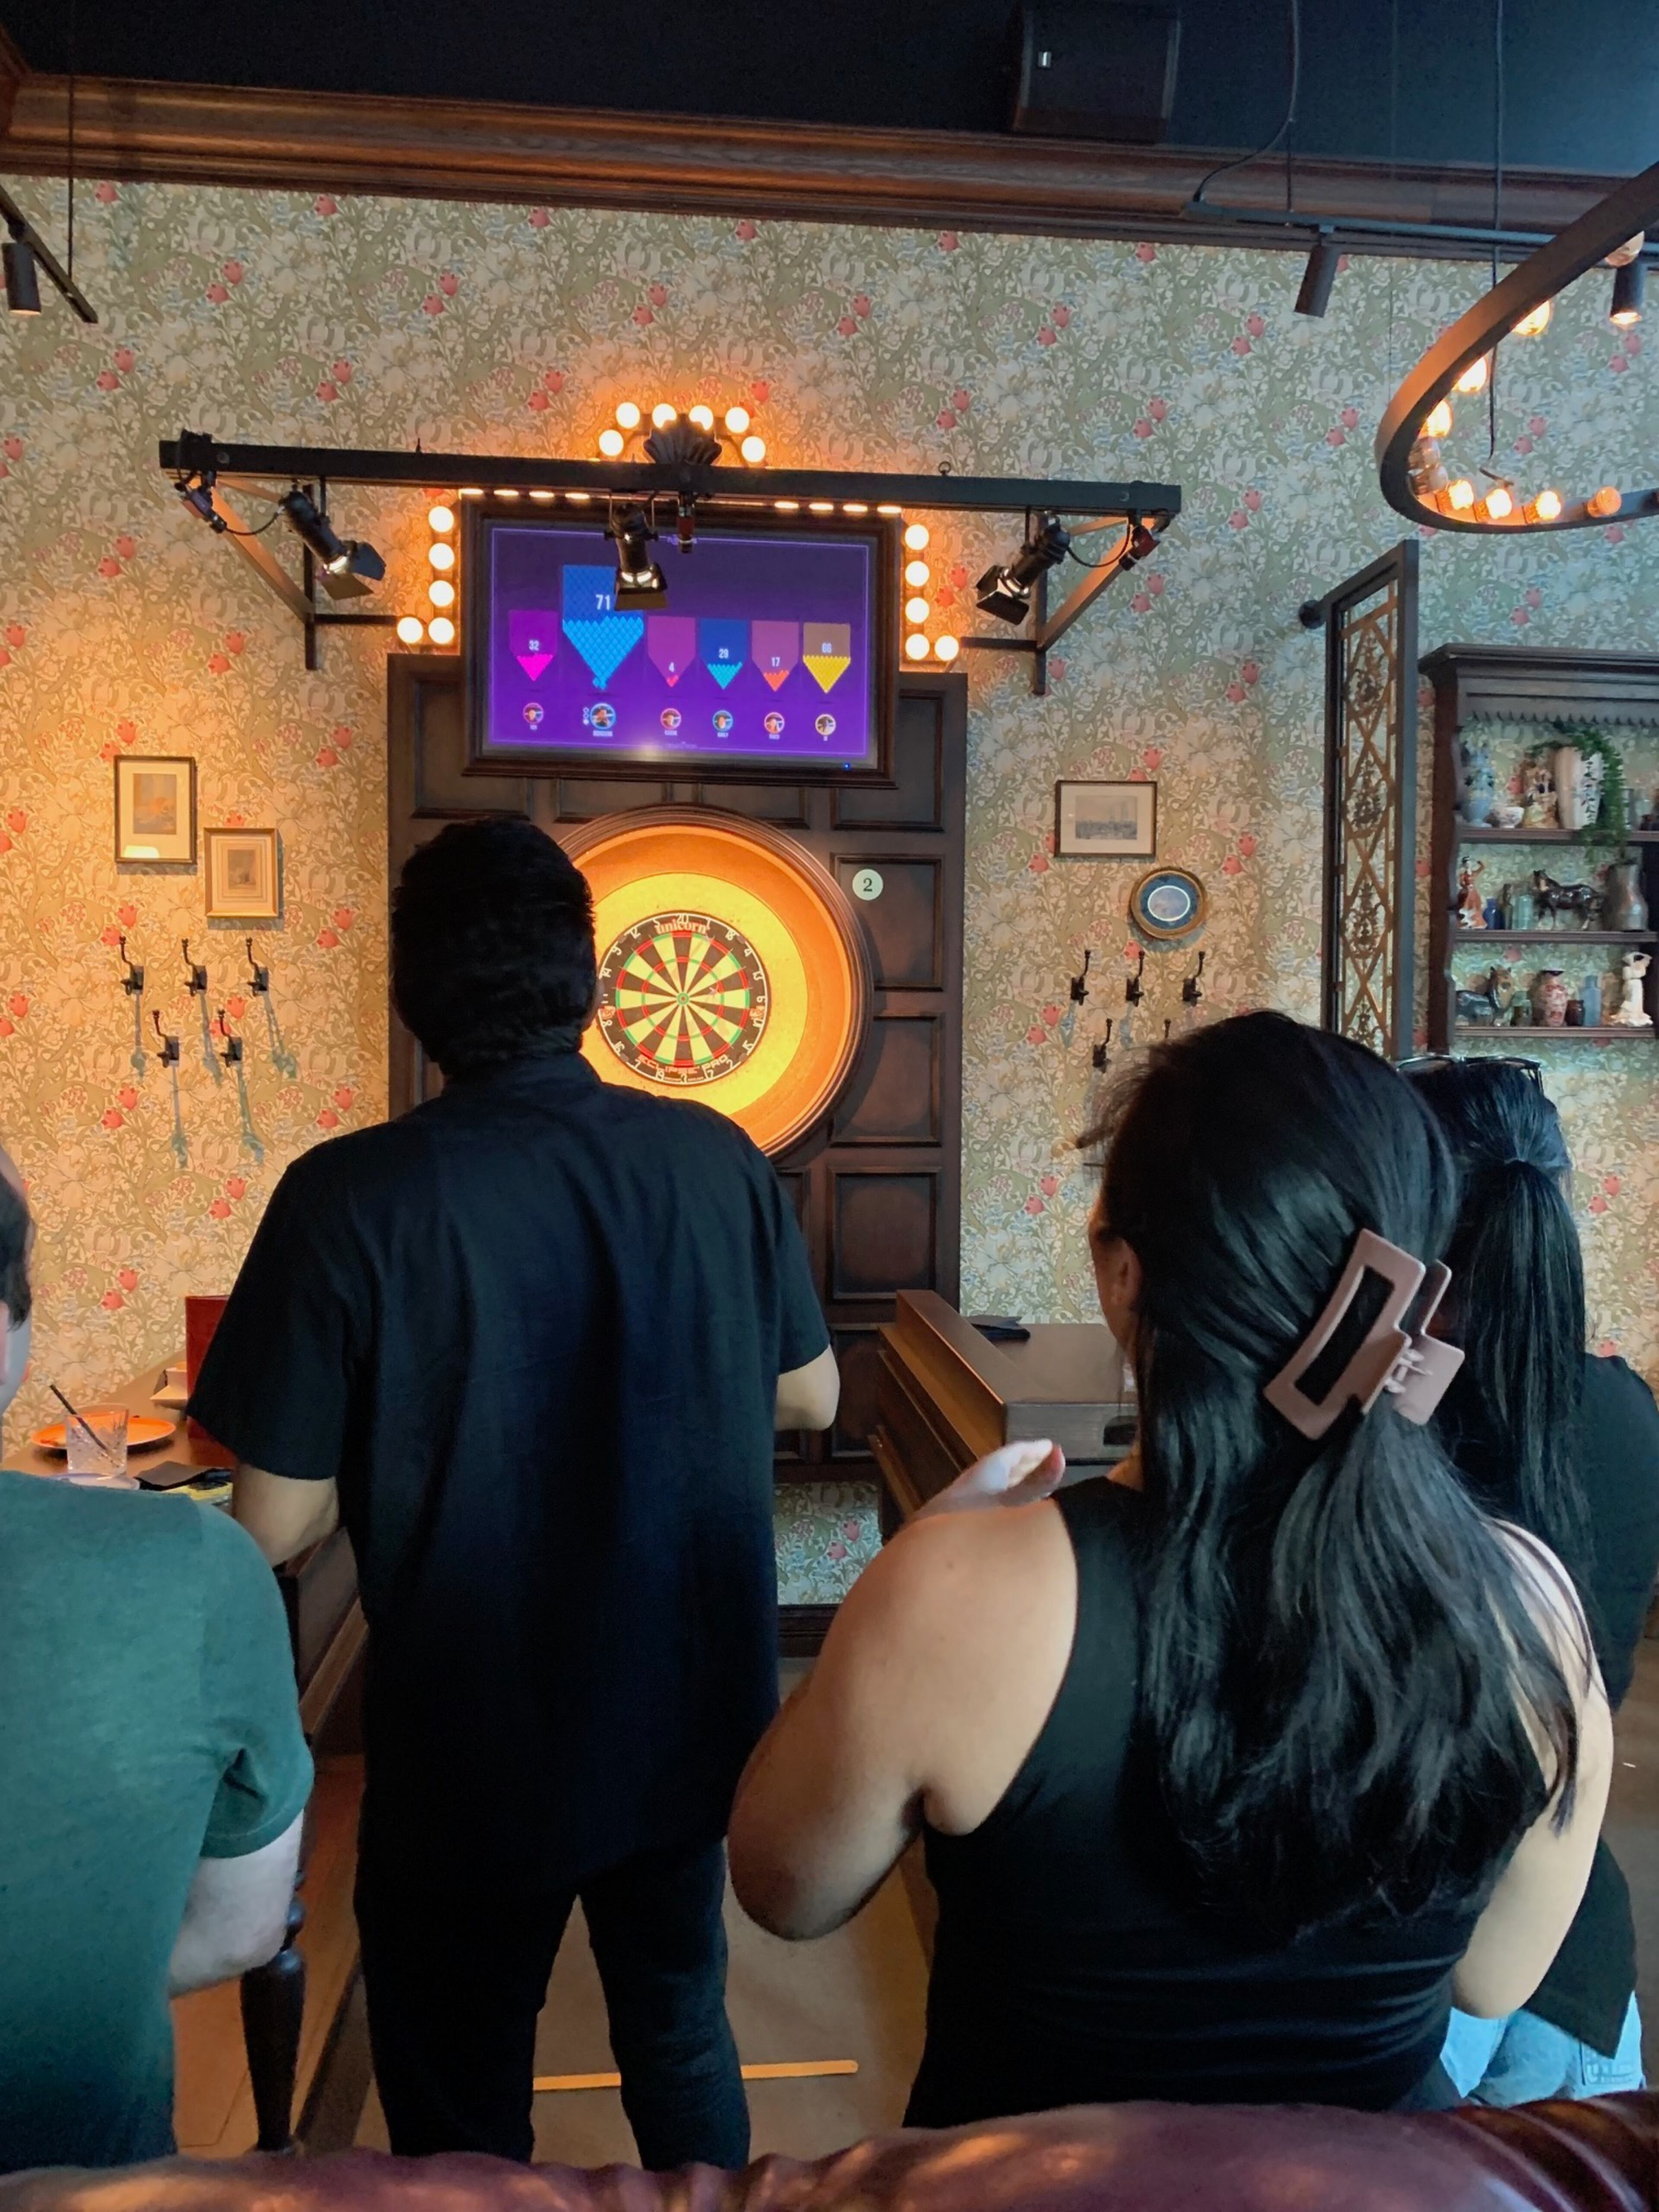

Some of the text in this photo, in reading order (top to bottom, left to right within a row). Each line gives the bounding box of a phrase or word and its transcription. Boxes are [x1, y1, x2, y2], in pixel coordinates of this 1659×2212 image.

[596, 594, 611, 610] 71
[528, 639, 540, 651] 32
[718, 648, 729, 659] 29
[668, 662, 675, 673] 4
[771, 657, 781, 667] 17
[863, 877, 873, 892] 2
[676, 914, 689, 925] 20
[654, 919, 708, 934] unicorn
[629, 928, 641, 939] 12
[725, 928, 737, 941] 18
[610, 946, 622, 956] 9
[744, 947, 753, 957] 4
[601, 967, 612, 978] 14
[752, 970, 764, 981] 13
[611, 1041, 625, 1057] 16
[742, 1039, 755, 1056] 15
[633, 1058, 642, 1068] 7
[637, 1054, 729, 1074] ECLIPSE PRO
[726, 1059, 734, 1069] 2
